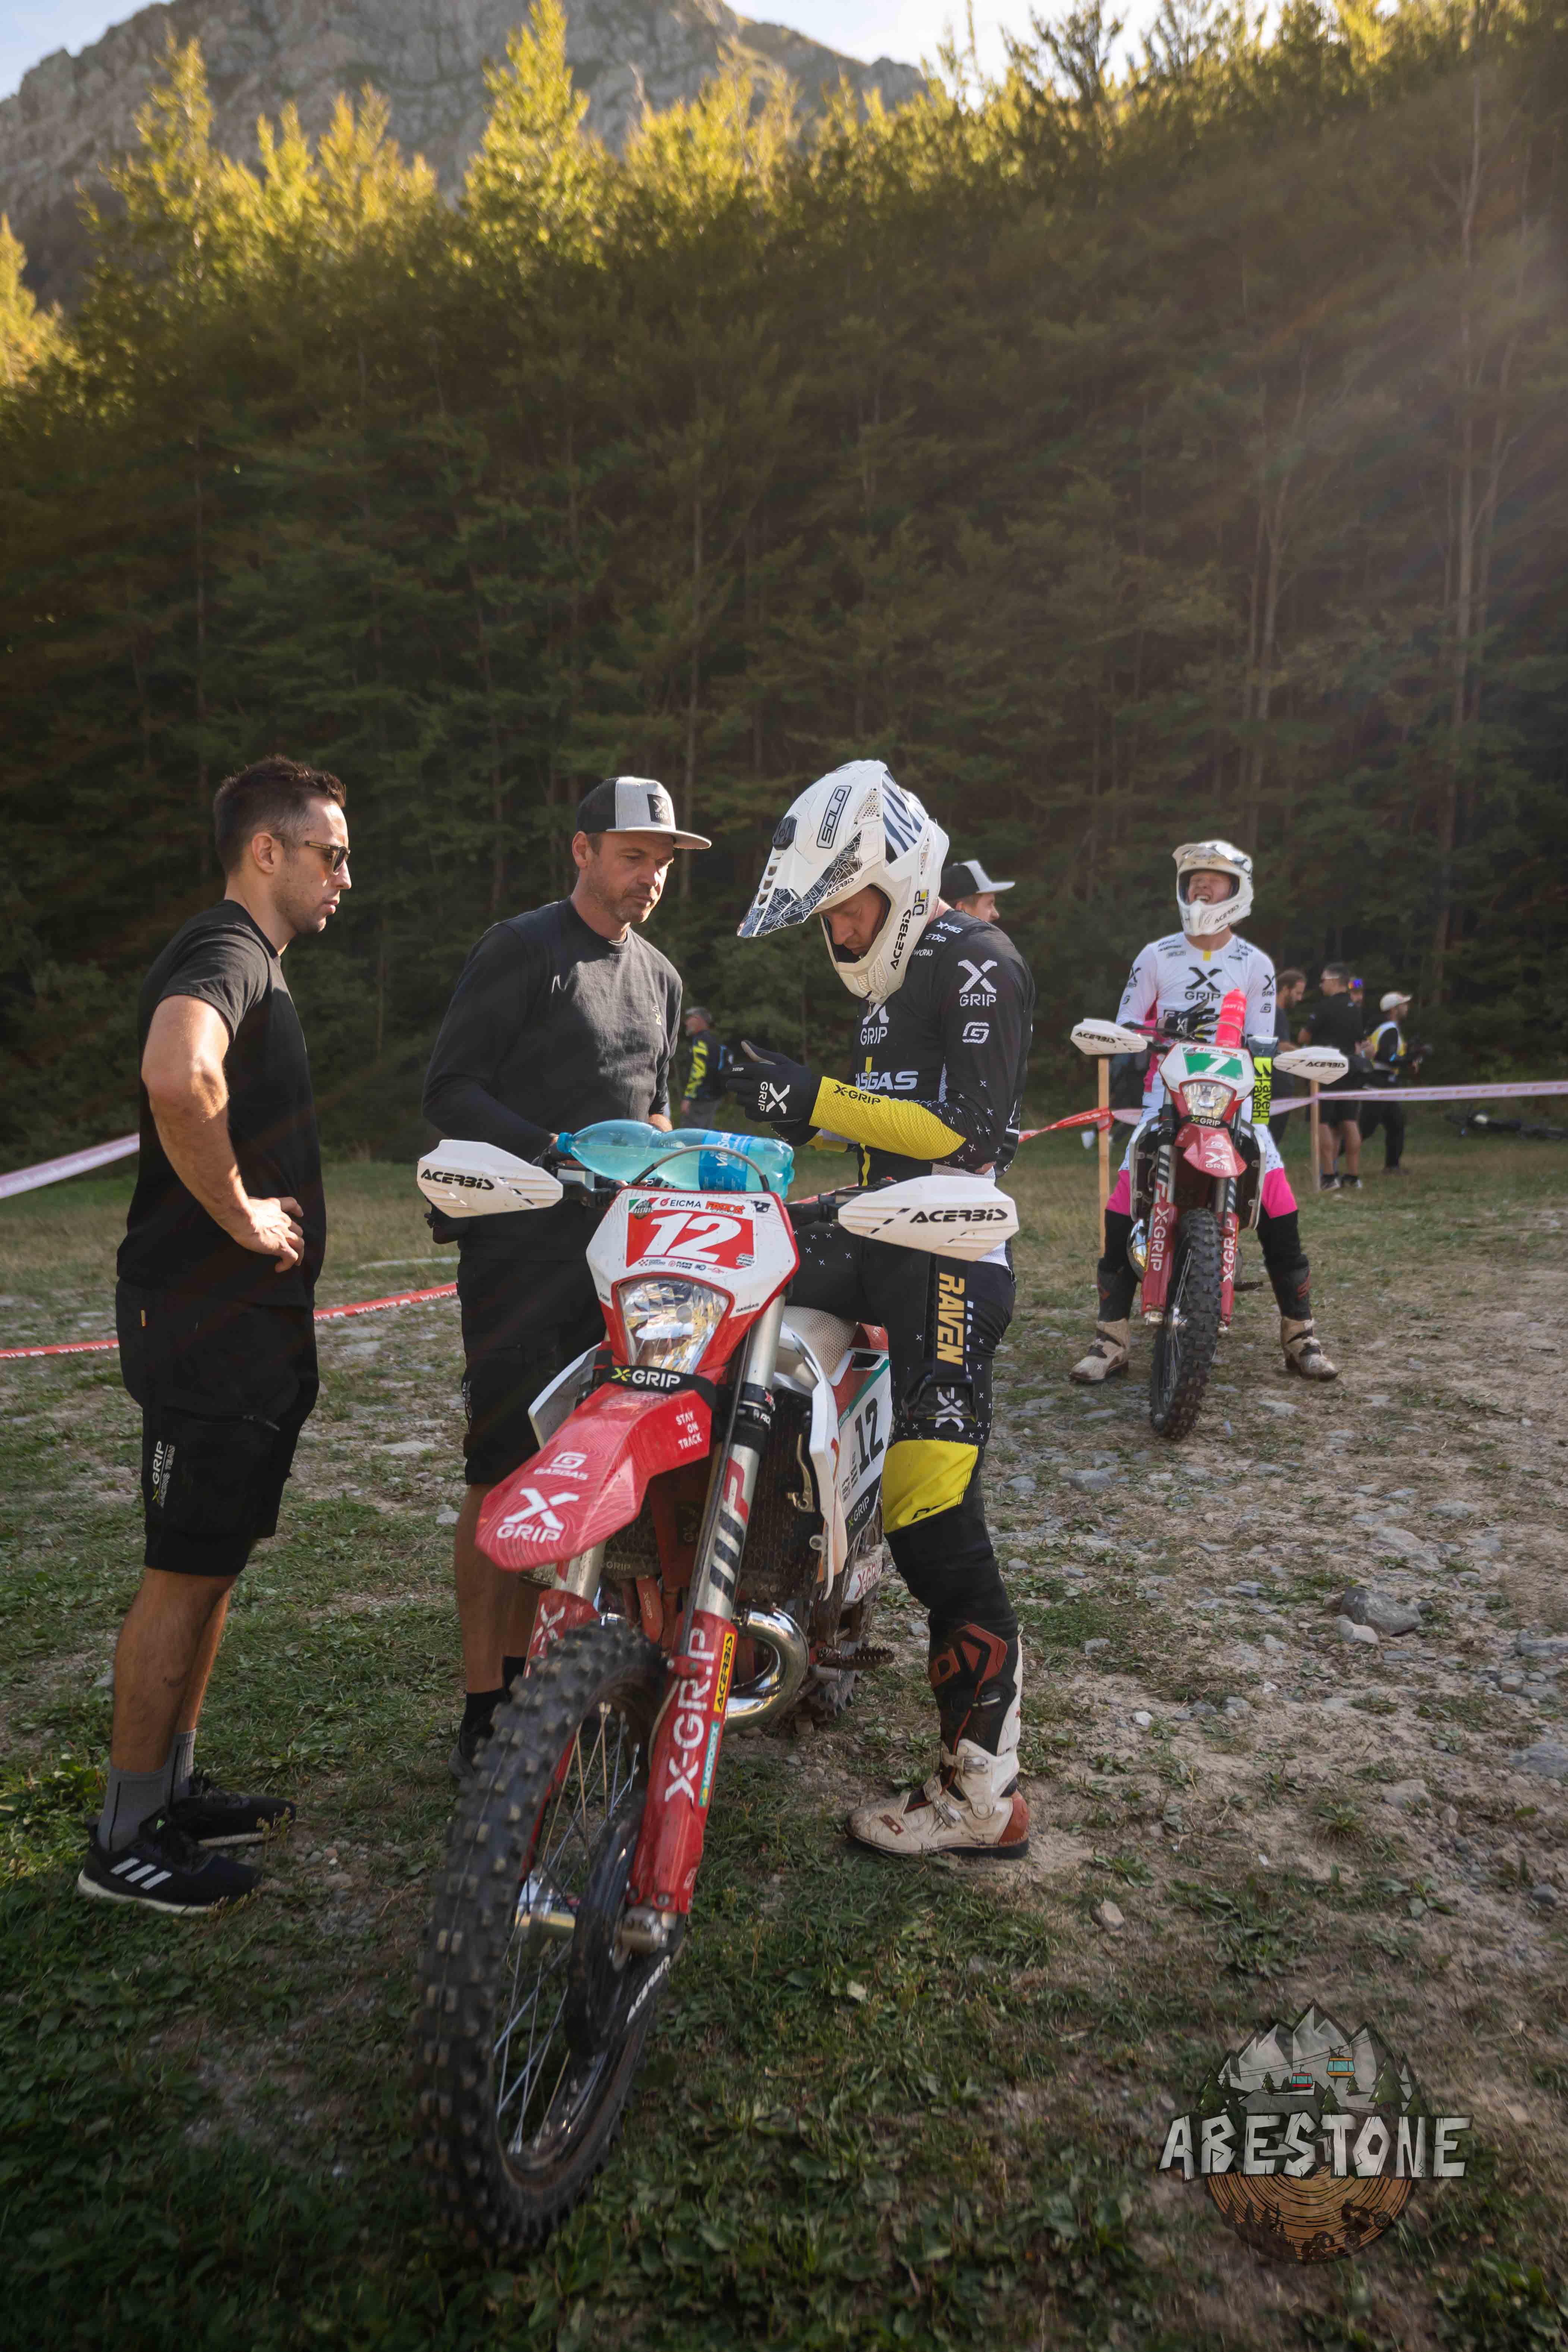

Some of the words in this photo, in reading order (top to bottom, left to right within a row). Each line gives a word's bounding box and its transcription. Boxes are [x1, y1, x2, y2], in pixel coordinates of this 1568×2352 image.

[821, 789, 846, 844] SOLO
[826, 877, 854, 898] ACERBIS
[890, 909, 912, 970] ACERBIS
[958, 960, 997, 993] X
[1186, 967, 1222, 993] X
[959, 994, 996, 1007] GRIP
[1185, 991, 1220, 1002] GRIP
[860, 1026, 887, 1045] GRIP
[1075, 1032, 1115, 1043] ACERBIS
[1204, 1054, 1231, 1073] 7
[758, 1081, 768, 1111] GRIP
[766, 1083, 790, 1114] X
[833, 1084, 881, 1105] X-GRIP
[1191, 1116, 1220, 1127] X-GRIP
[421, 1168, 495, 1190] ACERBIS
[670, 1199, 701, 1208] EICMA
[910, 1209, 1008, 1224] ACERBIS
[643, 1212, 742, 1263] 12
[1151, 1206, 1170, 1271] X-GRIP
[1223, 1219, 1235, 1282] X-GRP
[937, 1272, 965, 1366] RAVEN
[611, 1367, 681, 1388] X-GRIP
[676, 1410, 694, 1426] STAY
[687, 1420, 699, 1434] ON
[678, 1432, 703, 1450] TRACK
[855, 1398, 884, 1476] 12
[534, 1468, 589, 1480] GASGAS
[503, 1487, 579, 1531] X
[496, 1522, 561, 1544] GRIP
[717, 1635, 733, 1711] ACERBIS
[664, 1627, 715, 1806] X-GRP
